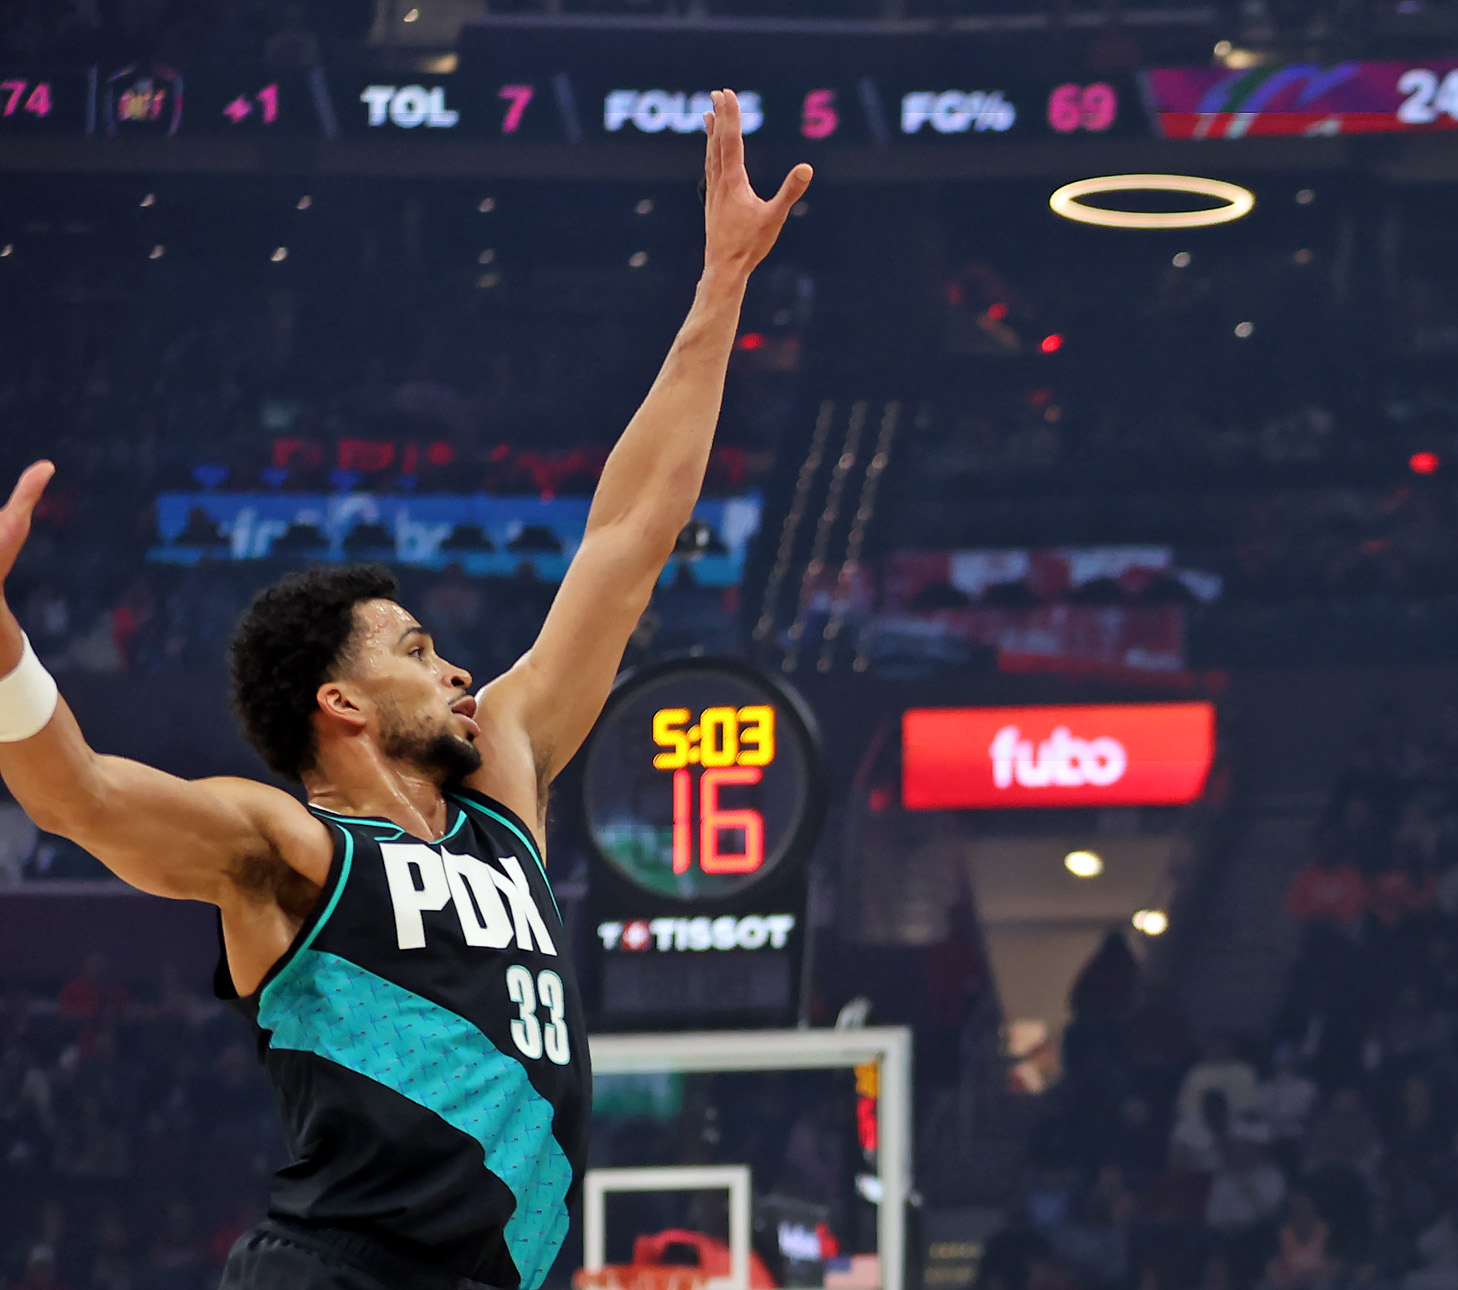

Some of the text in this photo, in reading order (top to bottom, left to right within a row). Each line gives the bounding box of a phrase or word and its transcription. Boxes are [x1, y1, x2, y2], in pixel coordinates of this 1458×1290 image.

[360, 84, 533, 132] TOL 7
[604, 89, 838, 138] FOUS 5
[901, 83, 1118, 133] FG% 69
[652, 705, 776, 769] 5:03
[988, 725, 1127, 789] fubo
[672, 767, 763, 875] 16
[379, 842, 557, 956] PDX
[650, 914, 795, 951] TISSOT
[506, 965, 571, 1066] 33
